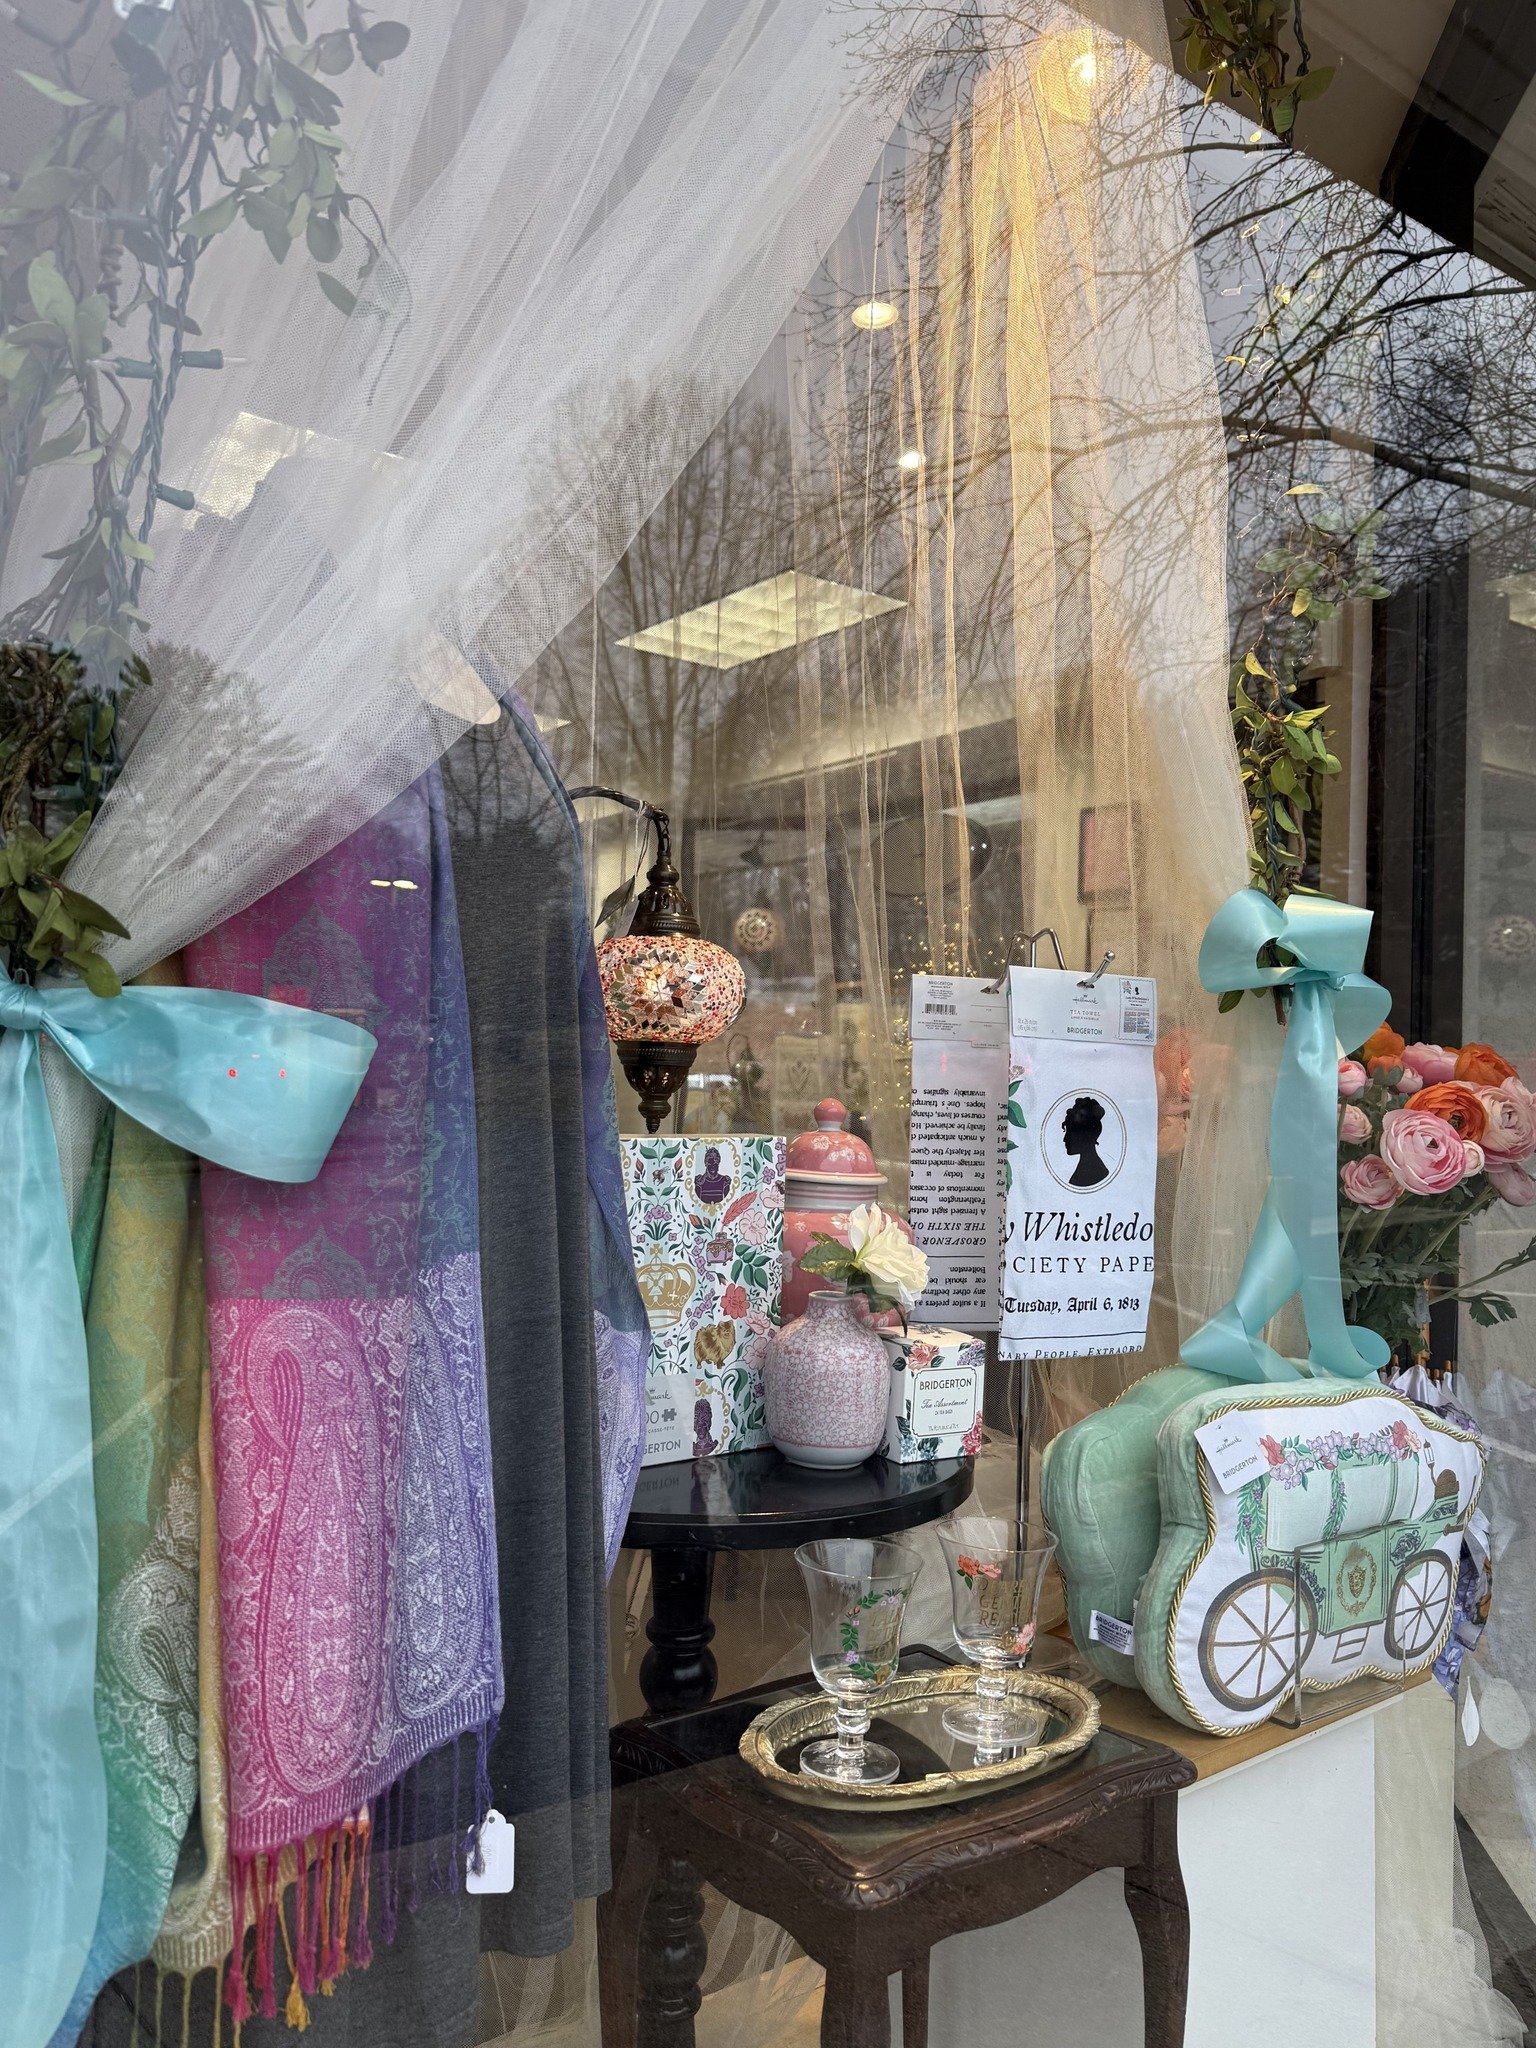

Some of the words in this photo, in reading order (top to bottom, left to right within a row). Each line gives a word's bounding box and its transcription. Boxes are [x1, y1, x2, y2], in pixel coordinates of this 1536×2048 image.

[1067, 1027, 1102, 1035] BRIDGERTON
[924, 1088, 949, 1096] signifies
[954, 1089, 985, 1097] invariably
[935, 1111, 952, 1119] lives,
[966, 1123, 985, 1131] finally
[919, 1133, 955, 1141] anticipated
[945, 1148, 971, 1156] Majesty
[928, 1159, 985, 1167] marriage-minded
[943, 1170, 963, 1178] today
[939, 1195, 986, 1204] Featherington
[932, 1206, 948, 1214] sight
[1024, 1212, 1153, 1241] Whistledo
[922, 1237, 986, 1245] GROSVENOR
[1013, 1256, 1086, 1273] CIETY
[1100, 1256, 1154, 1273] PAPE
[926, 1299, 949, 1307] prefers
[1004, 1297, 1061, 1314] Tuesday,
[1067, 1297, 1097, 1313] April
[1103, 1297, 1114, 1311] 6,
[1118, 1297, 1139, 1311] 1813
[920, 1378, 972, 1390] BRIDGERTON
[1223, 1455, 1258, 1479] BRIDGERTON
[1096, 1615, 1132, 1635] BRIDGERTON
